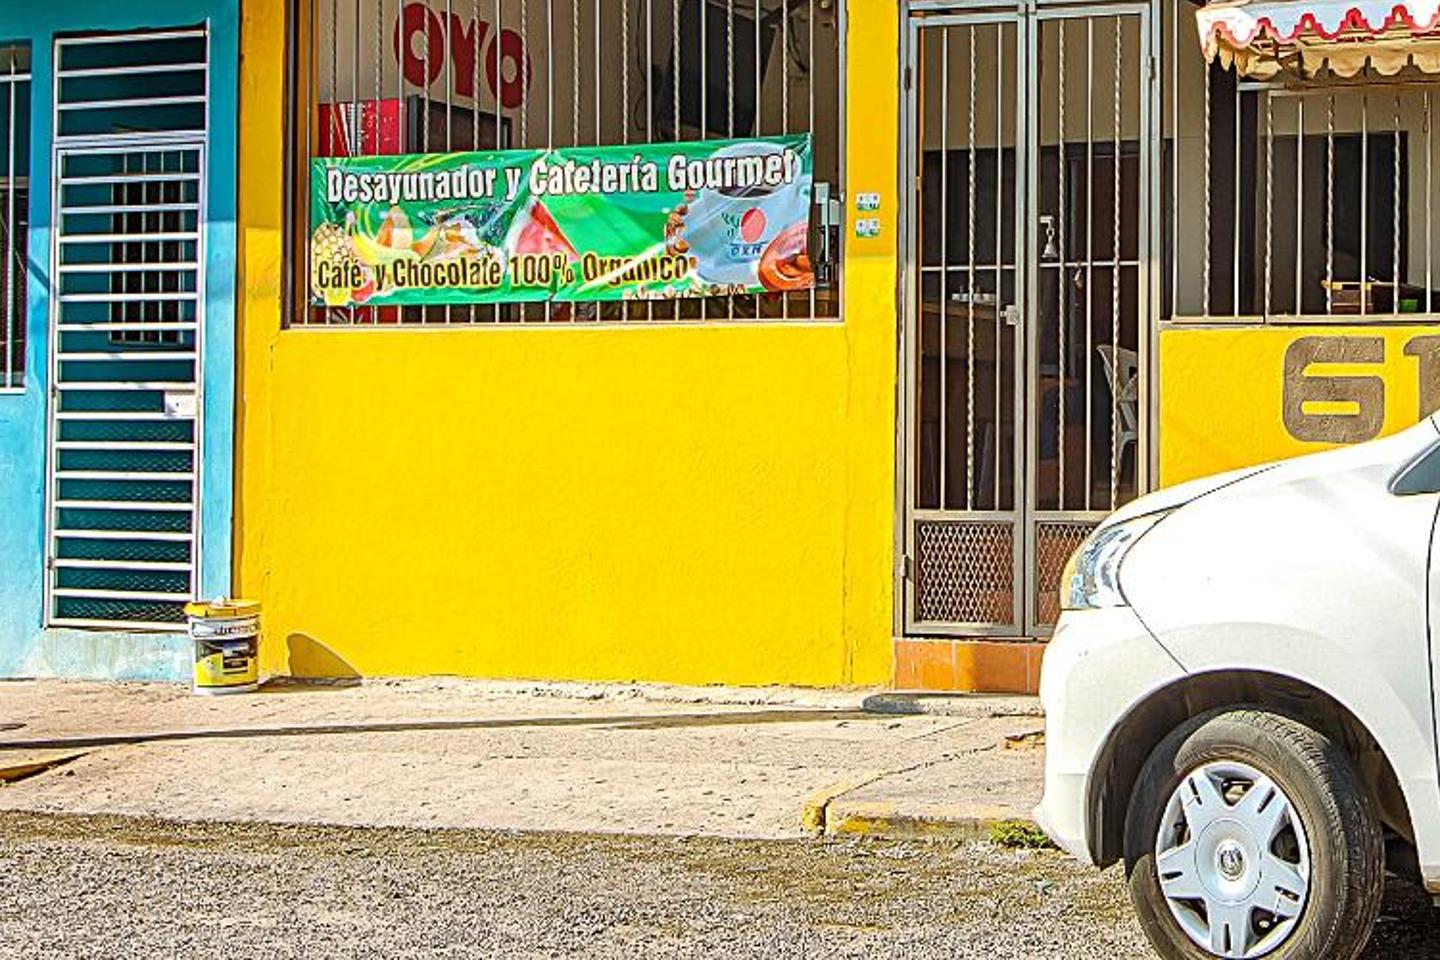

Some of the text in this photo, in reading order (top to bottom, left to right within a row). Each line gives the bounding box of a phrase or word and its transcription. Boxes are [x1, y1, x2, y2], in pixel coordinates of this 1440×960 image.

[393, 2, 532, 109] OYO
[327, 149, 798, 204] Desayunador y Cafetería Gourmet
[317, 257, 362, 289] Café
[375, 264, 387, 289] y
[392, 257, 501, 288] Chocolate
[509, 253, 575, 286] 100%
